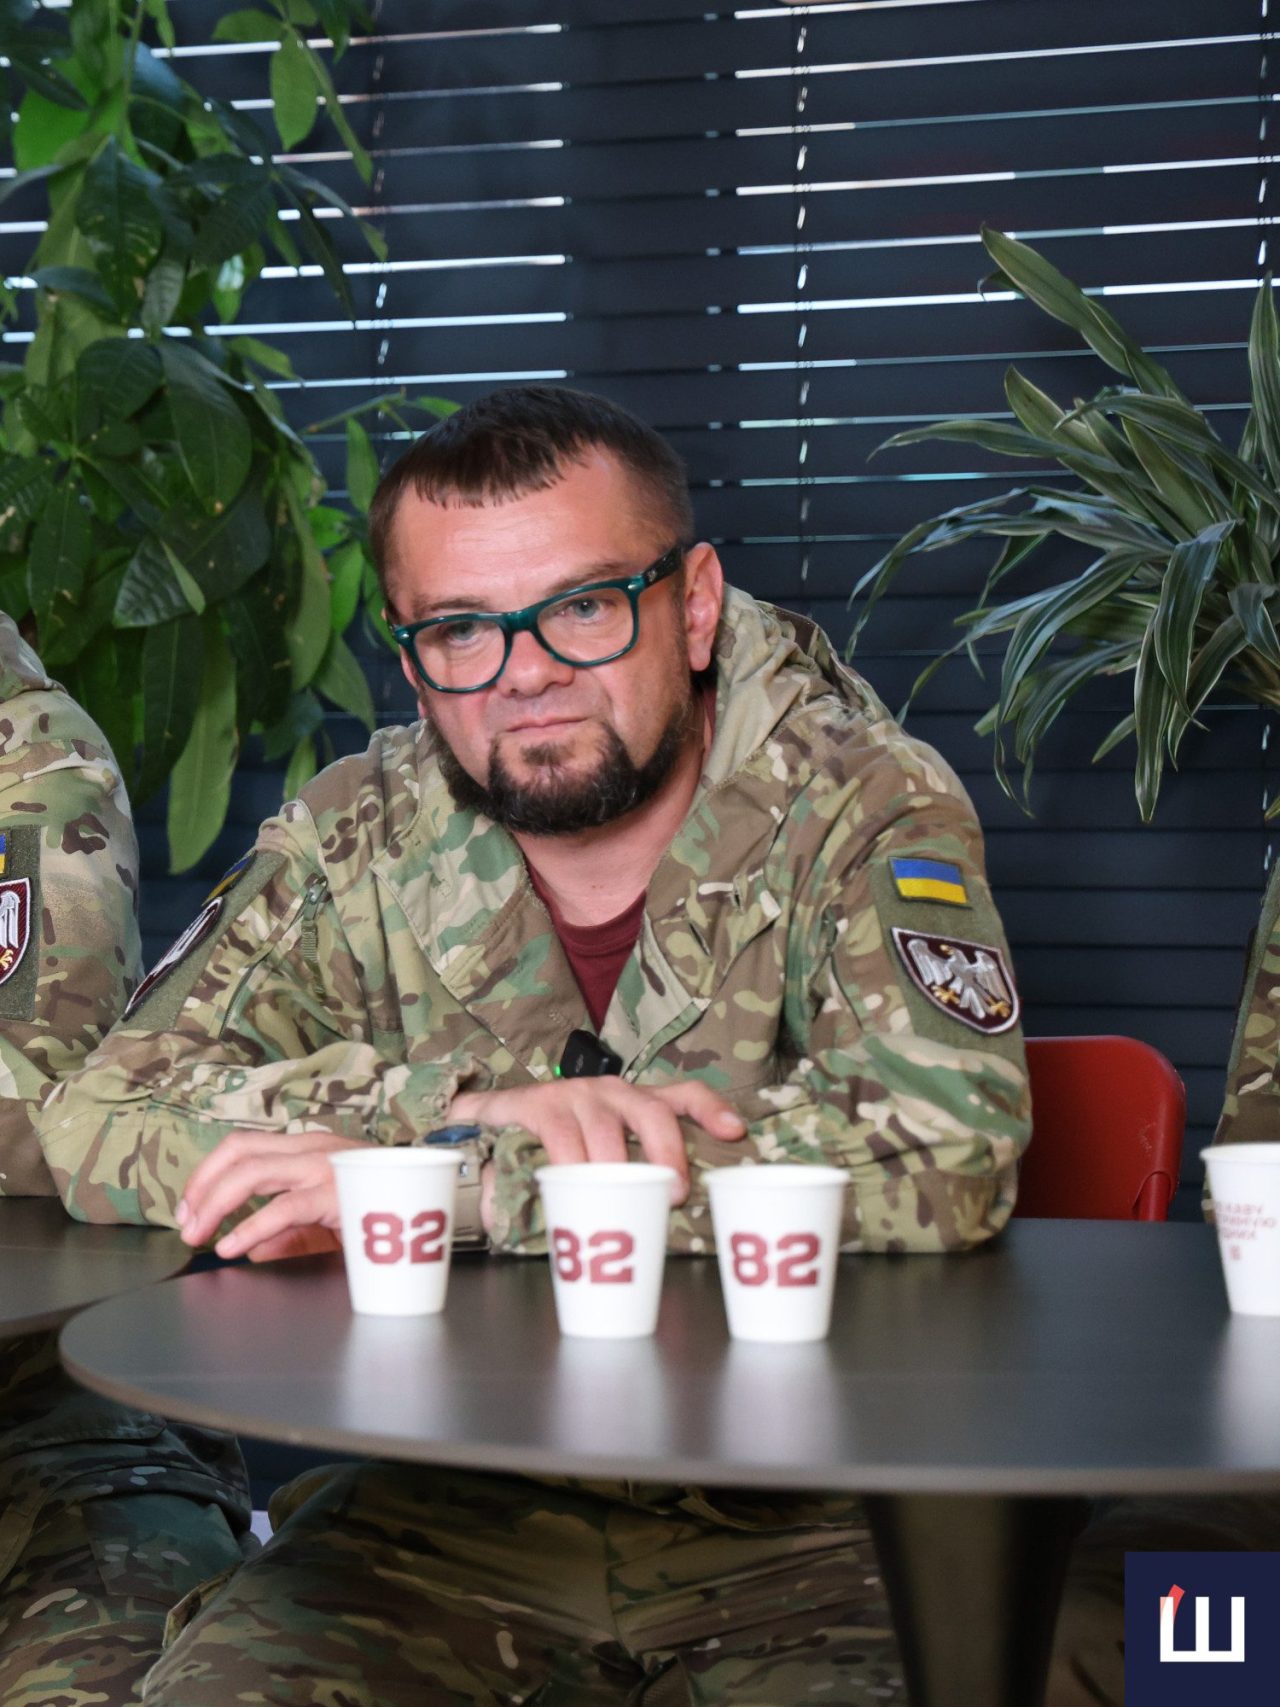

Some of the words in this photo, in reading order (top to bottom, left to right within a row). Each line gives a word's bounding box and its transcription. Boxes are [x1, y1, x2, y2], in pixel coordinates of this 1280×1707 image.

[362, 1210, 447, 1265] 82
[553, 1228, 634, 1284] 82
[730, 1232, 820, 1288] 82
